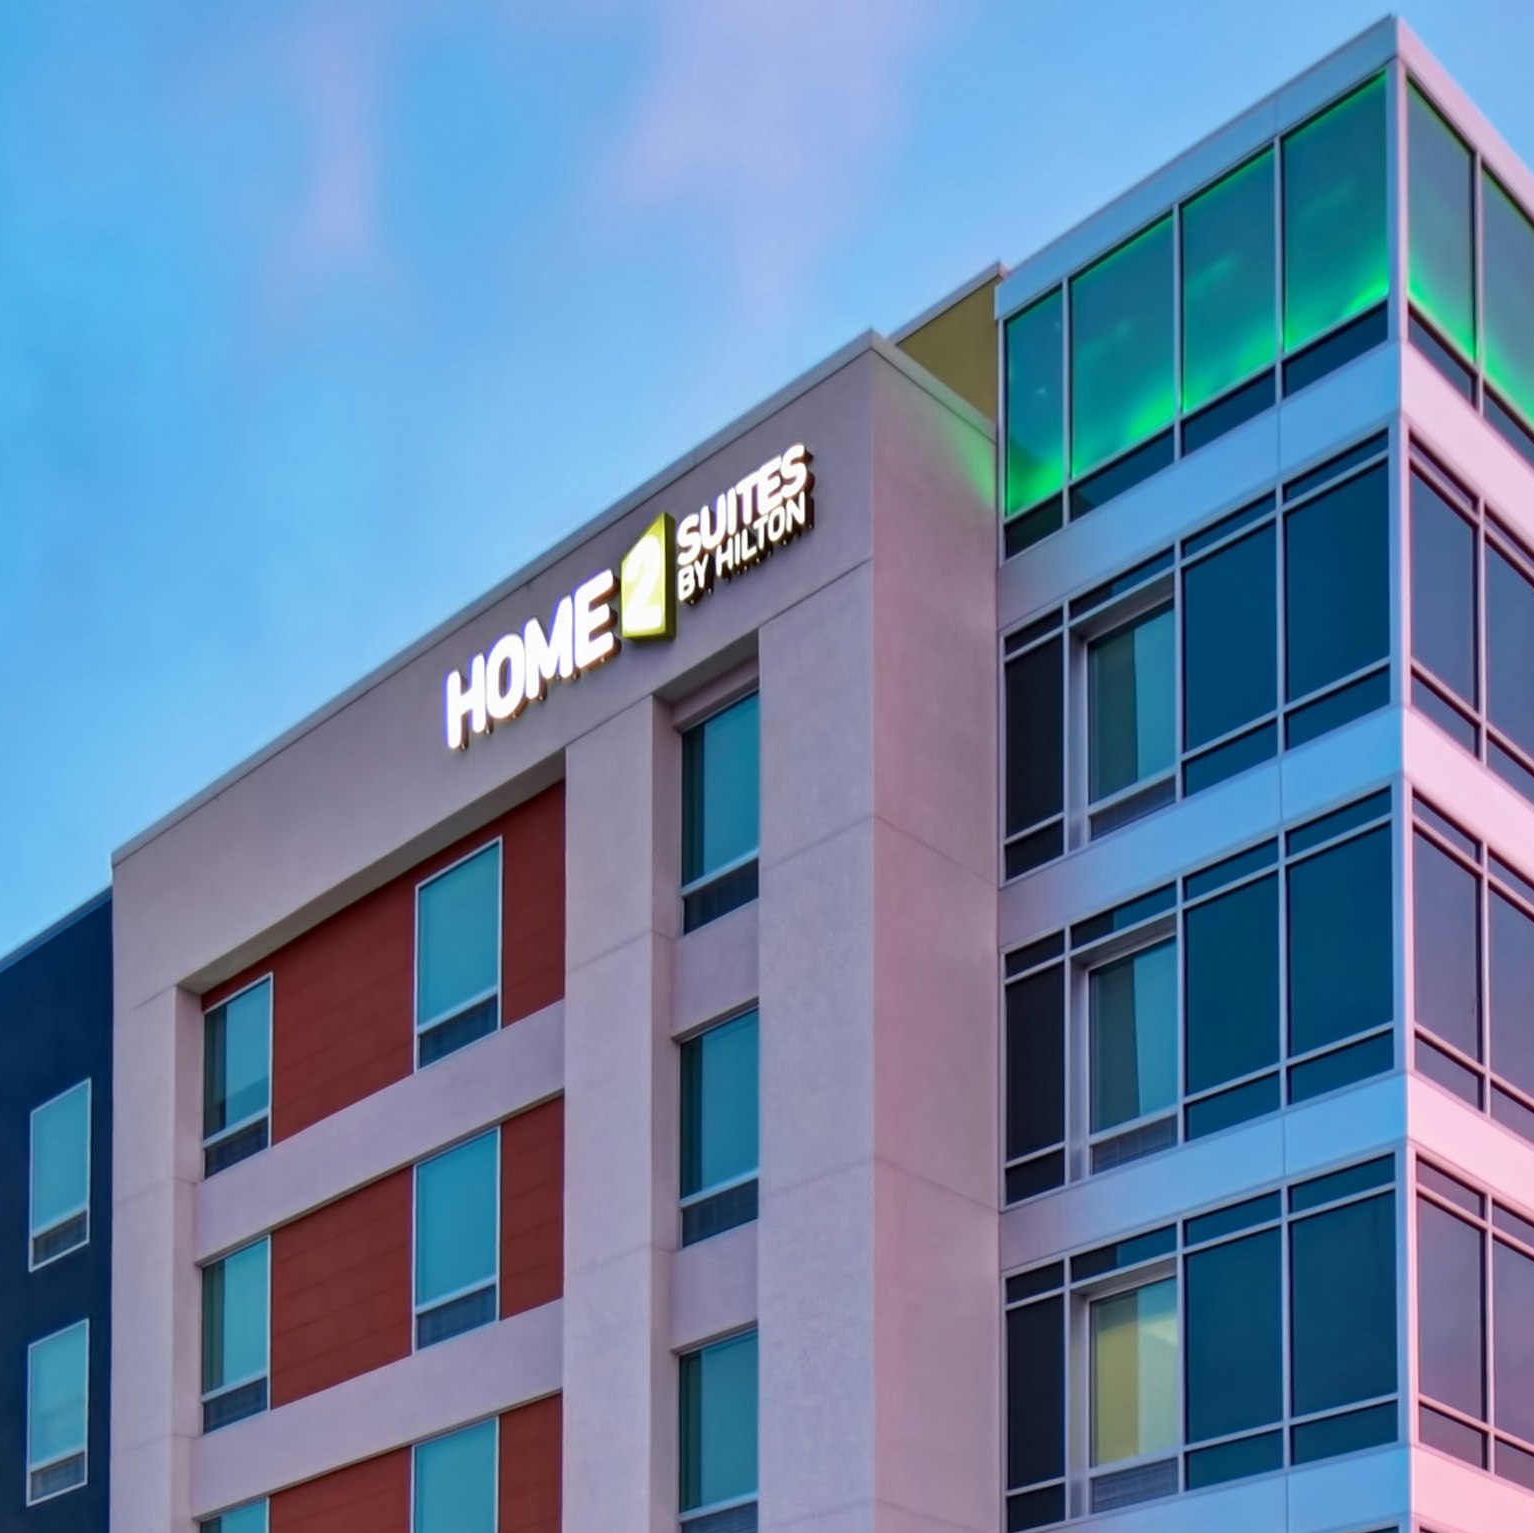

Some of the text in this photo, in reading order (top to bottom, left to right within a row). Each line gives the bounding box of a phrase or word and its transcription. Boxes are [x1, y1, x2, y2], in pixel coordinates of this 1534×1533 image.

[445, 568, 616, 750] HOME
[677, 443, 808, 567] SUITES
[677, 490, 806, 602] BY HILTON
